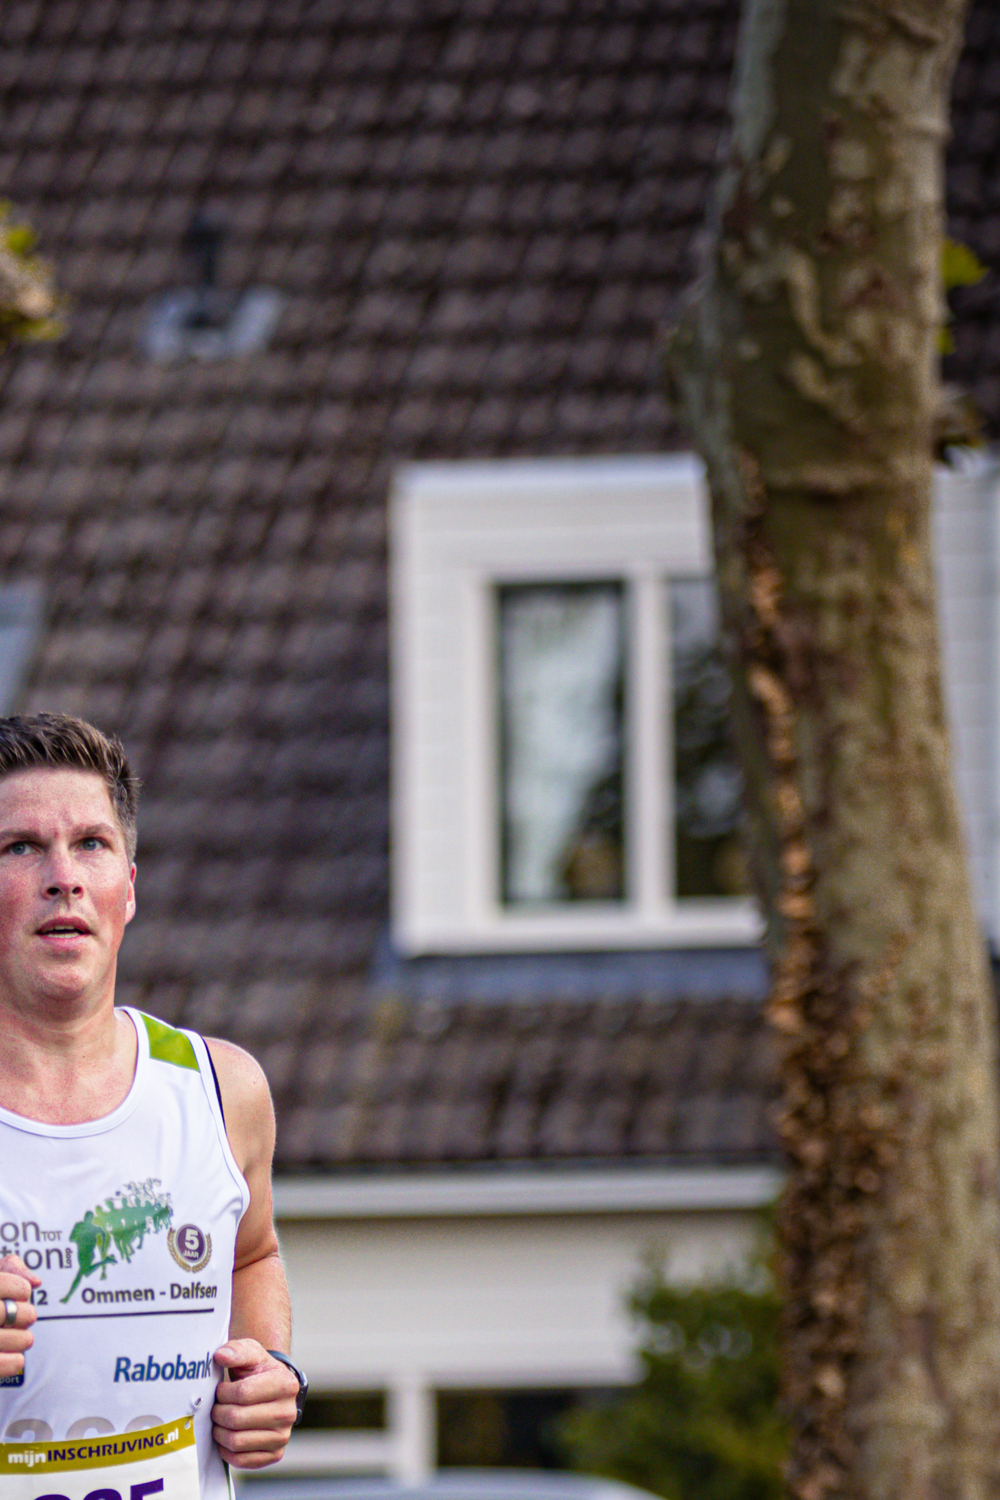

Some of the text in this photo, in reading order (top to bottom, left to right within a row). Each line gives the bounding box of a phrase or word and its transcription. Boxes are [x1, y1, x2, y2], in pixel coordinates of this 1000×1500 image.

[41, 1230, 63, 1242] TOT
[184, 1228, 200, 1251] 5
[182, 1250, 200, 1259] JAAR
[81, 1287, 156, 1304] Ommen
[170, 1281, 218, 1300] Dalfsen
[113, 1351, 213, 1383] Rabobank
[7, 1427, 180, 1468] mijnINSCHRIJVING.nl
